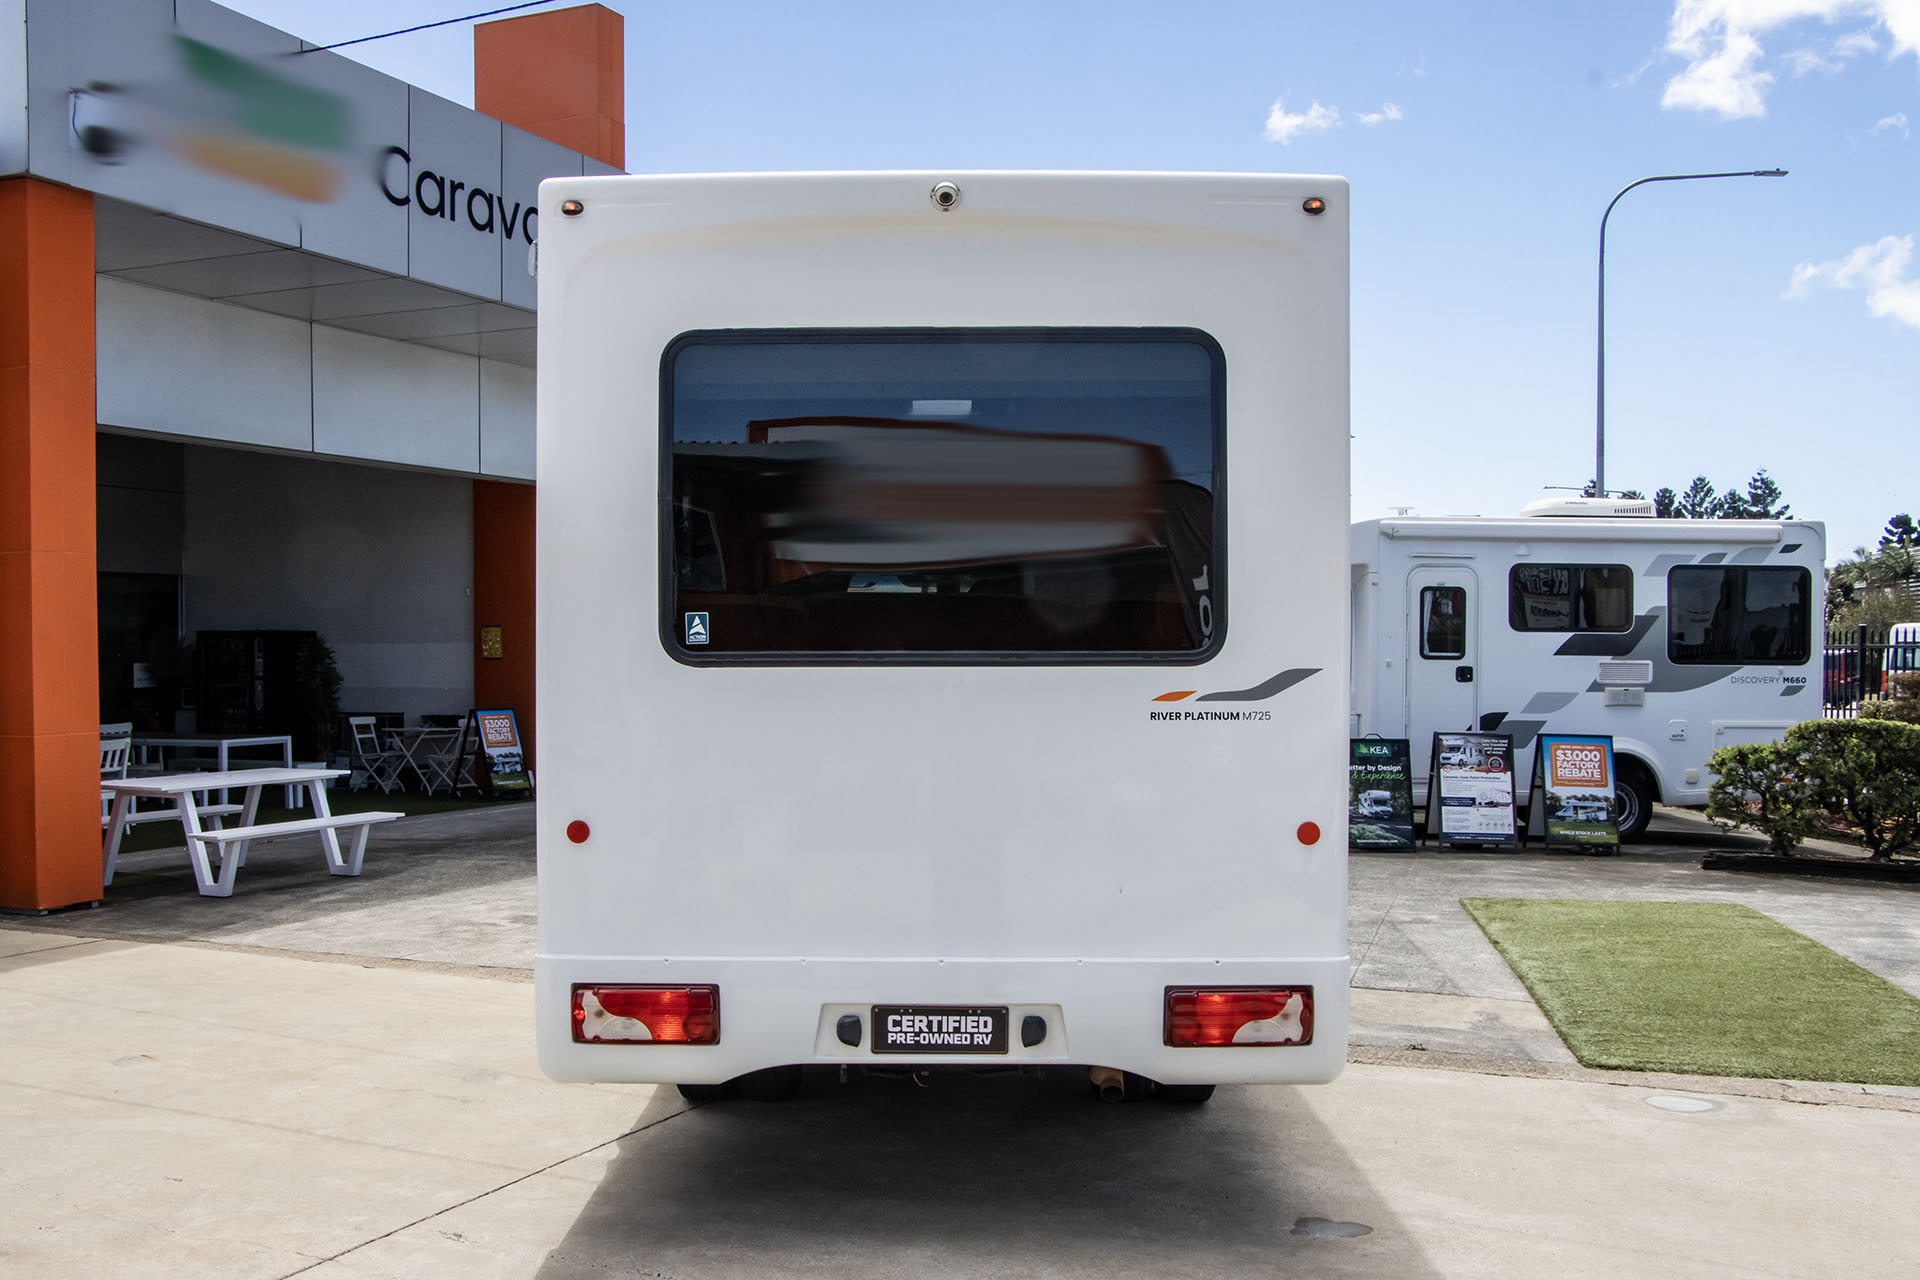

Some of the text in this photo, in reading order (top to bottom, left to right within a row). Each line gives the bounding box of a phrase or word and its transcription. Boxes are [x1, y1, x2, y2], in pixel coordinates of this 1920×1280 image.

[1730, 676, 1807, 684] DISCOVERY M660
[1150, 711, 1272, 721] RIVER PLATINUM M725
[1370, 746, 1389, 754] KEA
[1367, 764, 1376, 772] by
[1377, 764, 1402, 772] Design
[1557, 761, 1600, 769] FACTORY
[1360, 770, 1406, 783] Experience
[1557, 768, 1601, 778] REBATE
[887, 1015, 993, 1033] CERTIFIED
[887, 1033, 993, 1045] PRE-OWNED RV
